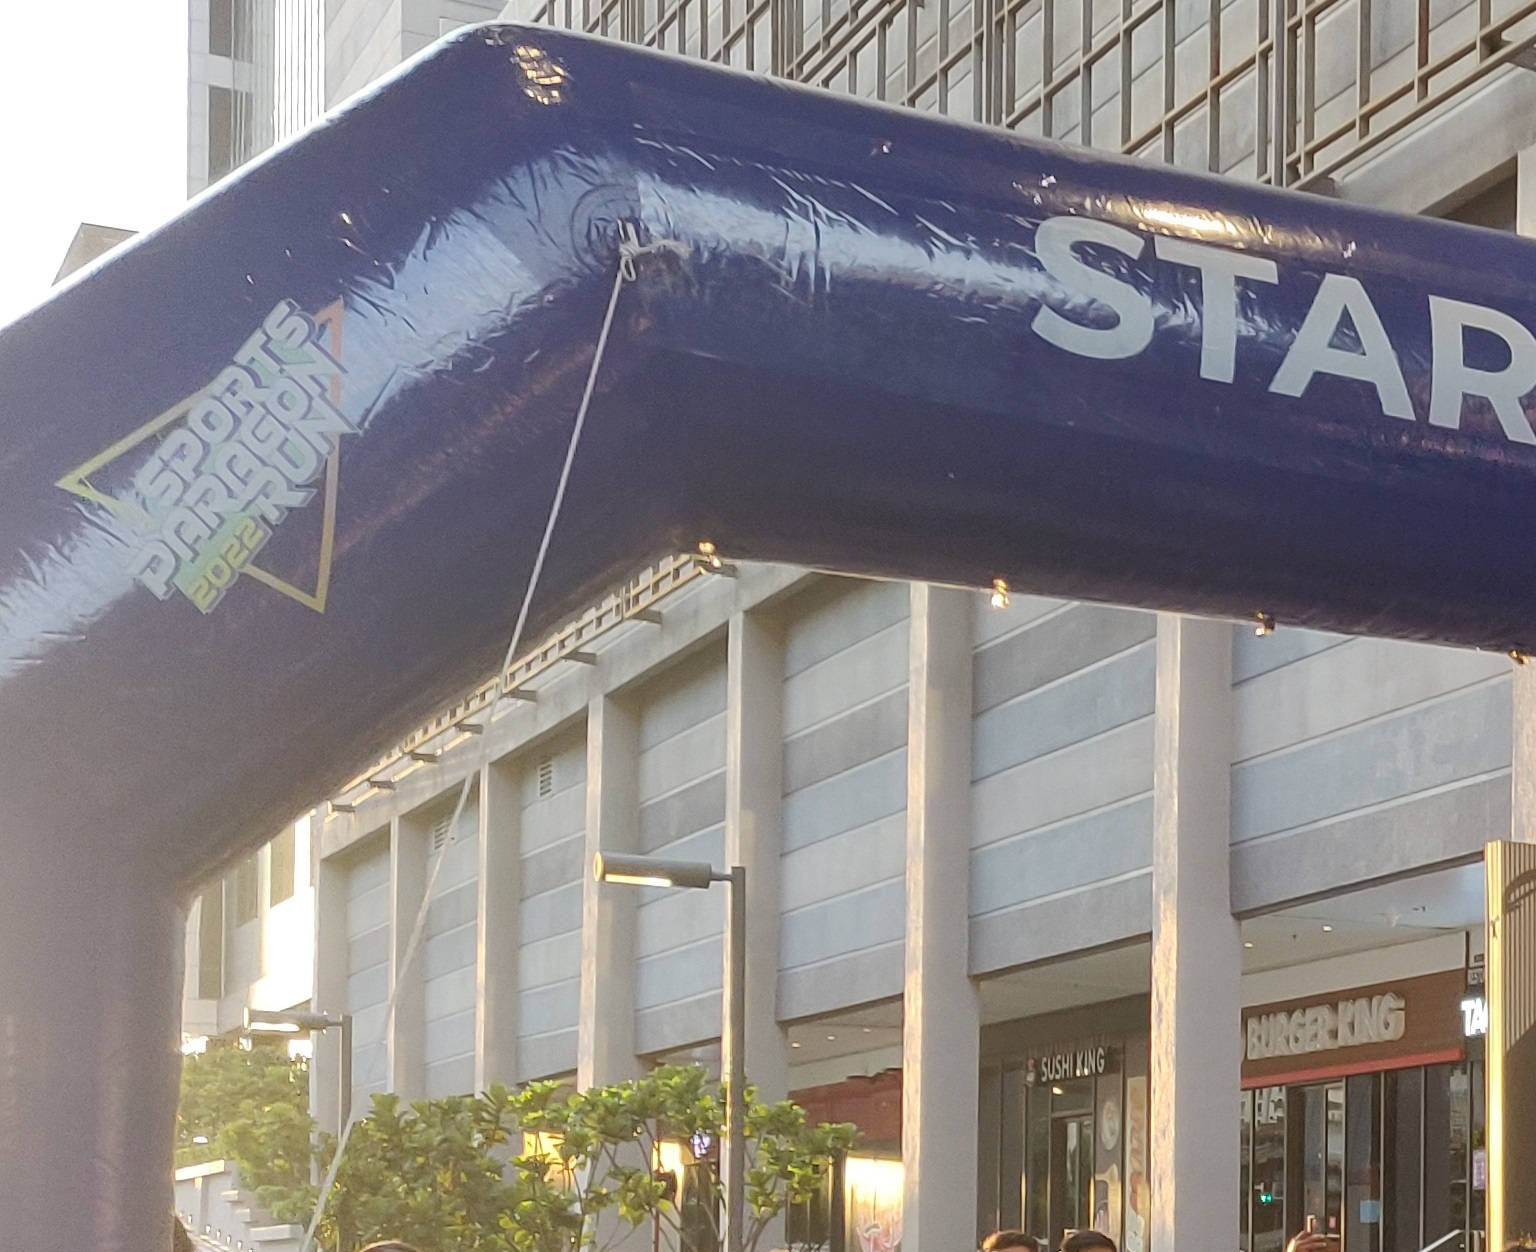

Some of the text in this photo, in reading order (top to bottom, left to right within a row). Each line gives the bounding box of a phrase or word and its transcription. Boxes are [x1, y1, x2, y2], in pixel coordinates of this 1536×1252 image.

[133, 297, 320, 506] SPORTS
[130, 335, 349, 600] PARAGON
[250, 404, 363, 526] RUN
[186, 515, 268, 608] 2022
[1247, 991, 1406, 1060] BURGER KING
[1460, 996, 1489, 1037] TA
[1040, 1046, 1105, 1083] SUSHI KING
